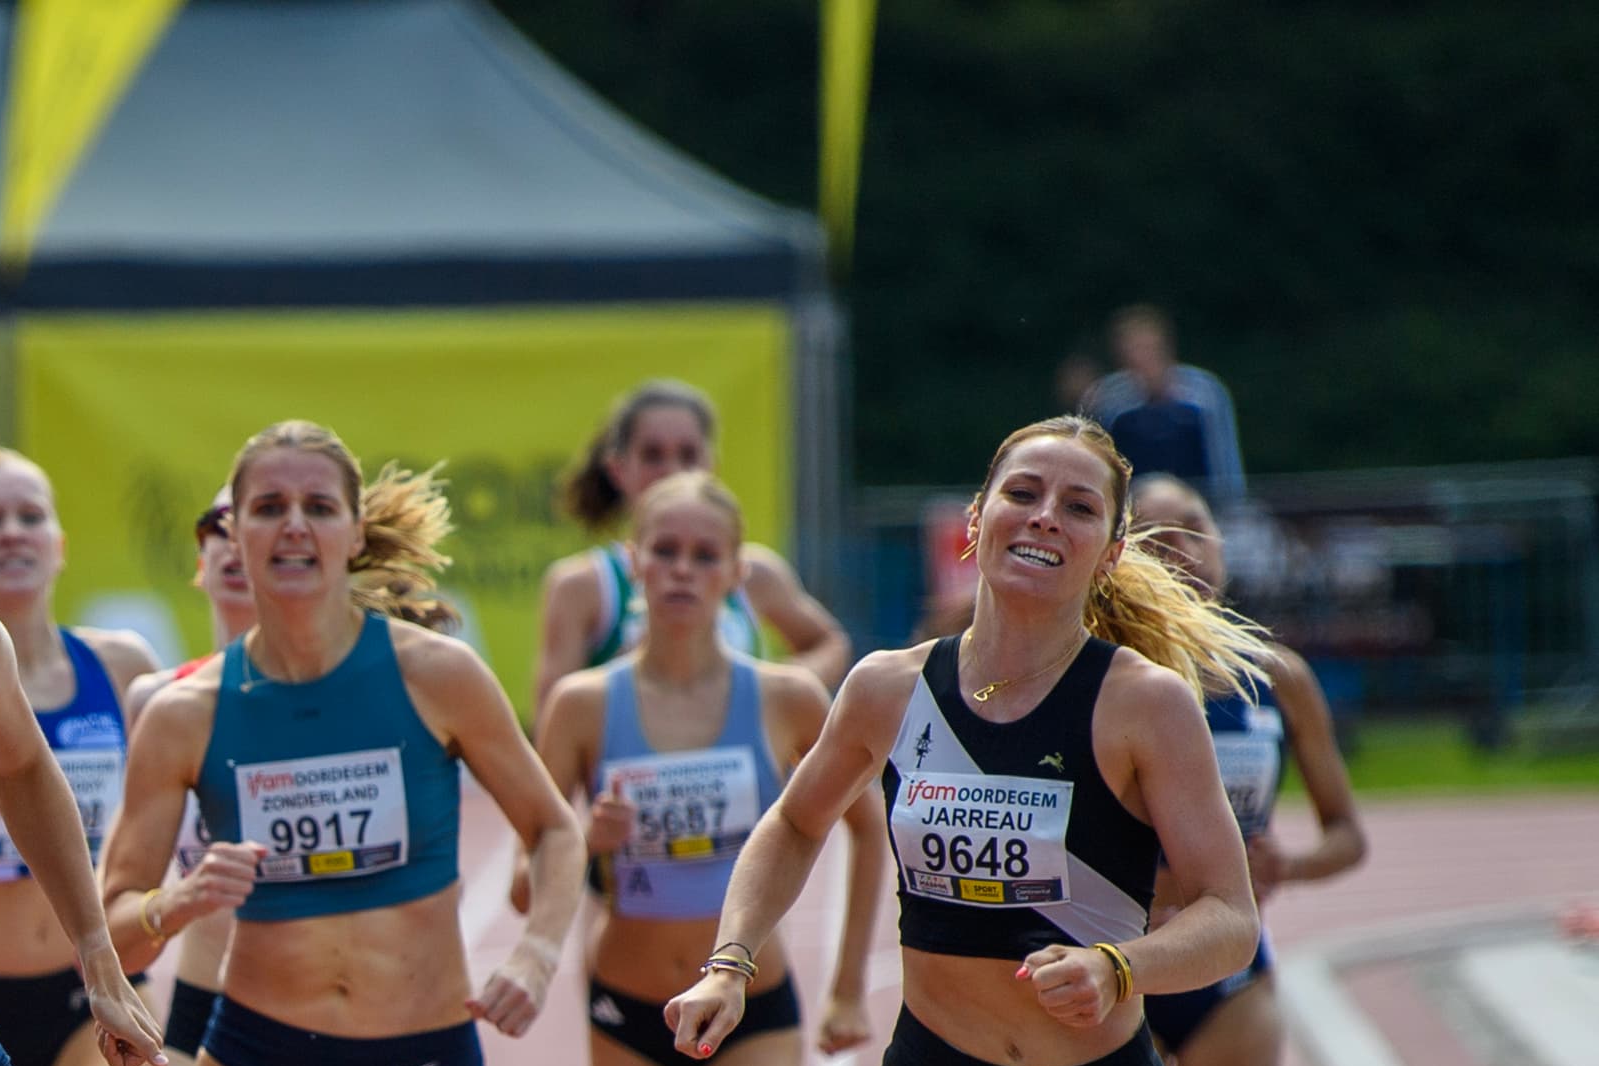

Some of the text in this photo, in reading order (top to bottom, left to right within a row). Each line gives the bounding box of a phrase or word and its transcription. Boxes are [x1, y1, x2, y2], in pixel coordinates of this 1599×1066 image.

[262, 784, 380, 812] ZONDERLAND
[271, 809, 372, 853] 9917
[921, 806, 1033, 831] JARREAU
[921, 833, 1030, 878] 9648
